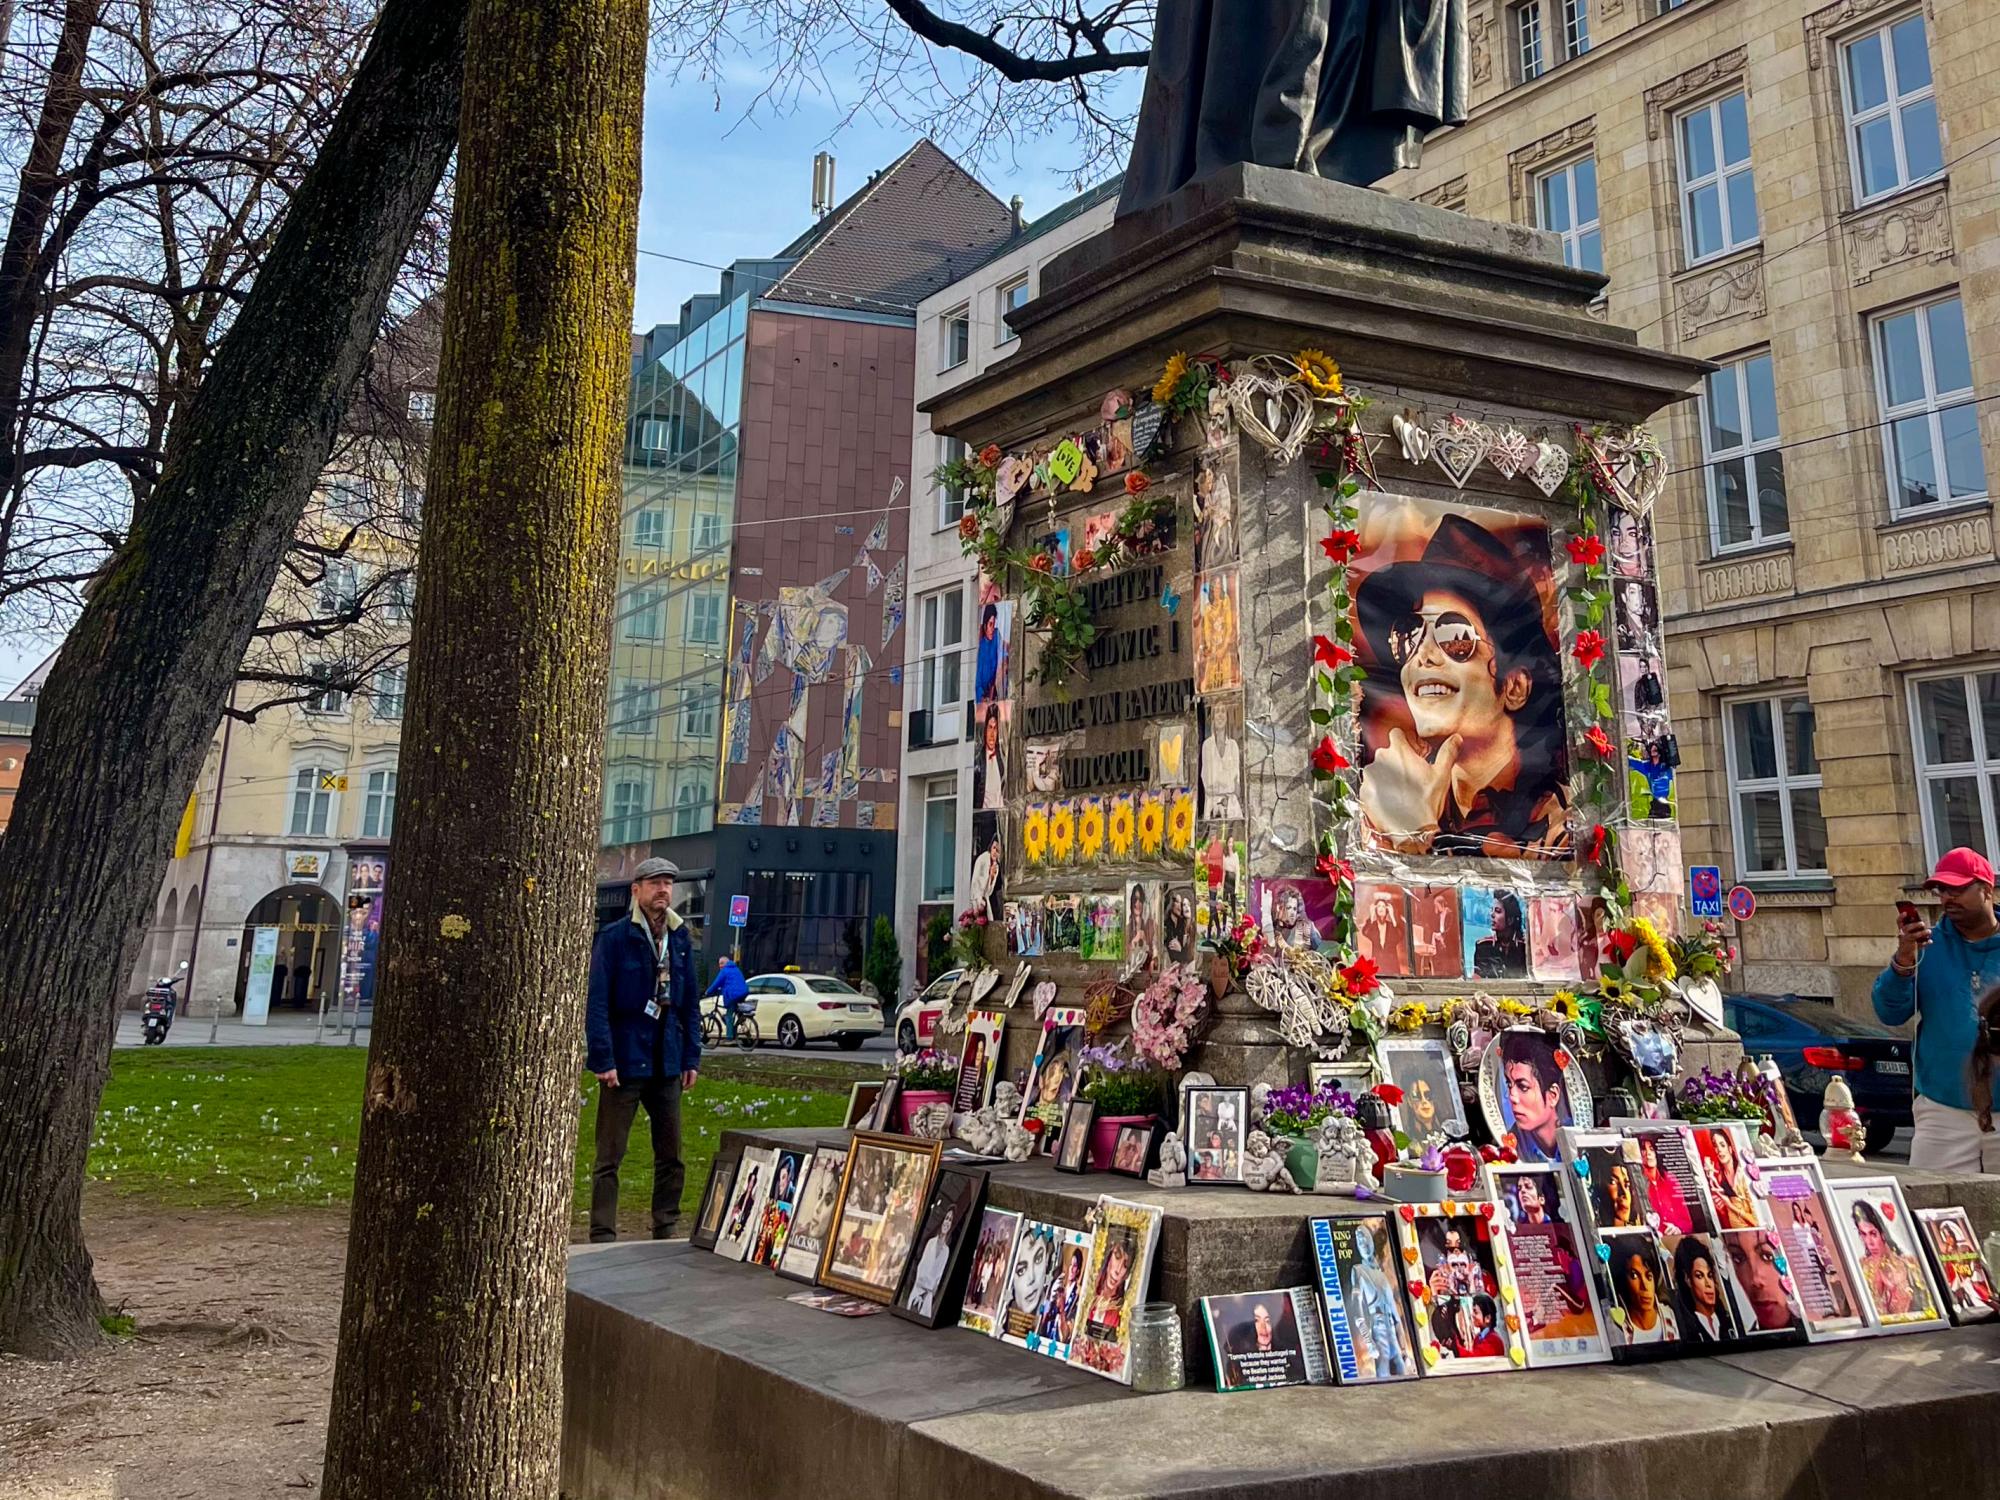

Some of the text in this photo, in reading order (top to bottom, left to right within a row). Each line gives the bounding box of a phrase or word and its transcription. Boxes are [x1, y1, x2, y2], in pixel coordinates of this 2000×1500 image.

[1088, 691, 1121, 727] VON
[1694, 900, 1720, 914] TAXI
[1333, 1230, 1352, 1241] KING
[1339, 1241, 1348, 1249] OF
[1338, 1249, 1353, 1260] POP
[1314, 1221, 1359, 1380] MICHAEL JACKSON
